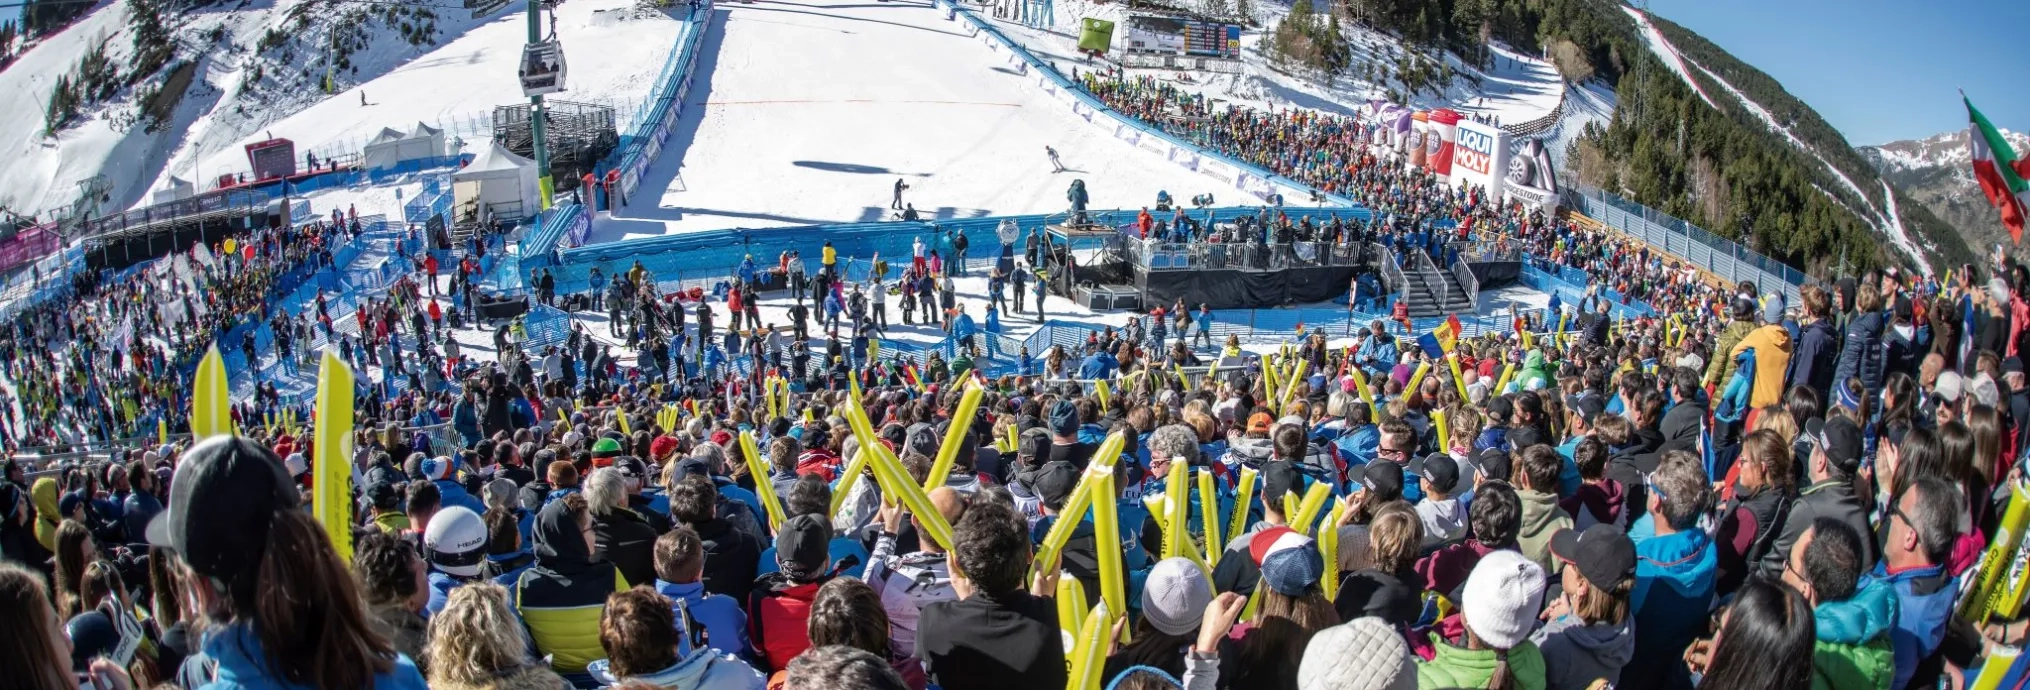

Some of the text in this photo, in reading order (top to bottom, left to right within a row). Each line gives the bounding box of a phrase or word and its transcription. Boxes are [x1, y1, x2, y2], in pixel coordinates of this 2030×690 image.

[1458, 127, 1491, 155] LIQUI
[1456, 146, 1490, 174] MOLY
[457, 537, 482, 548] HEAD
